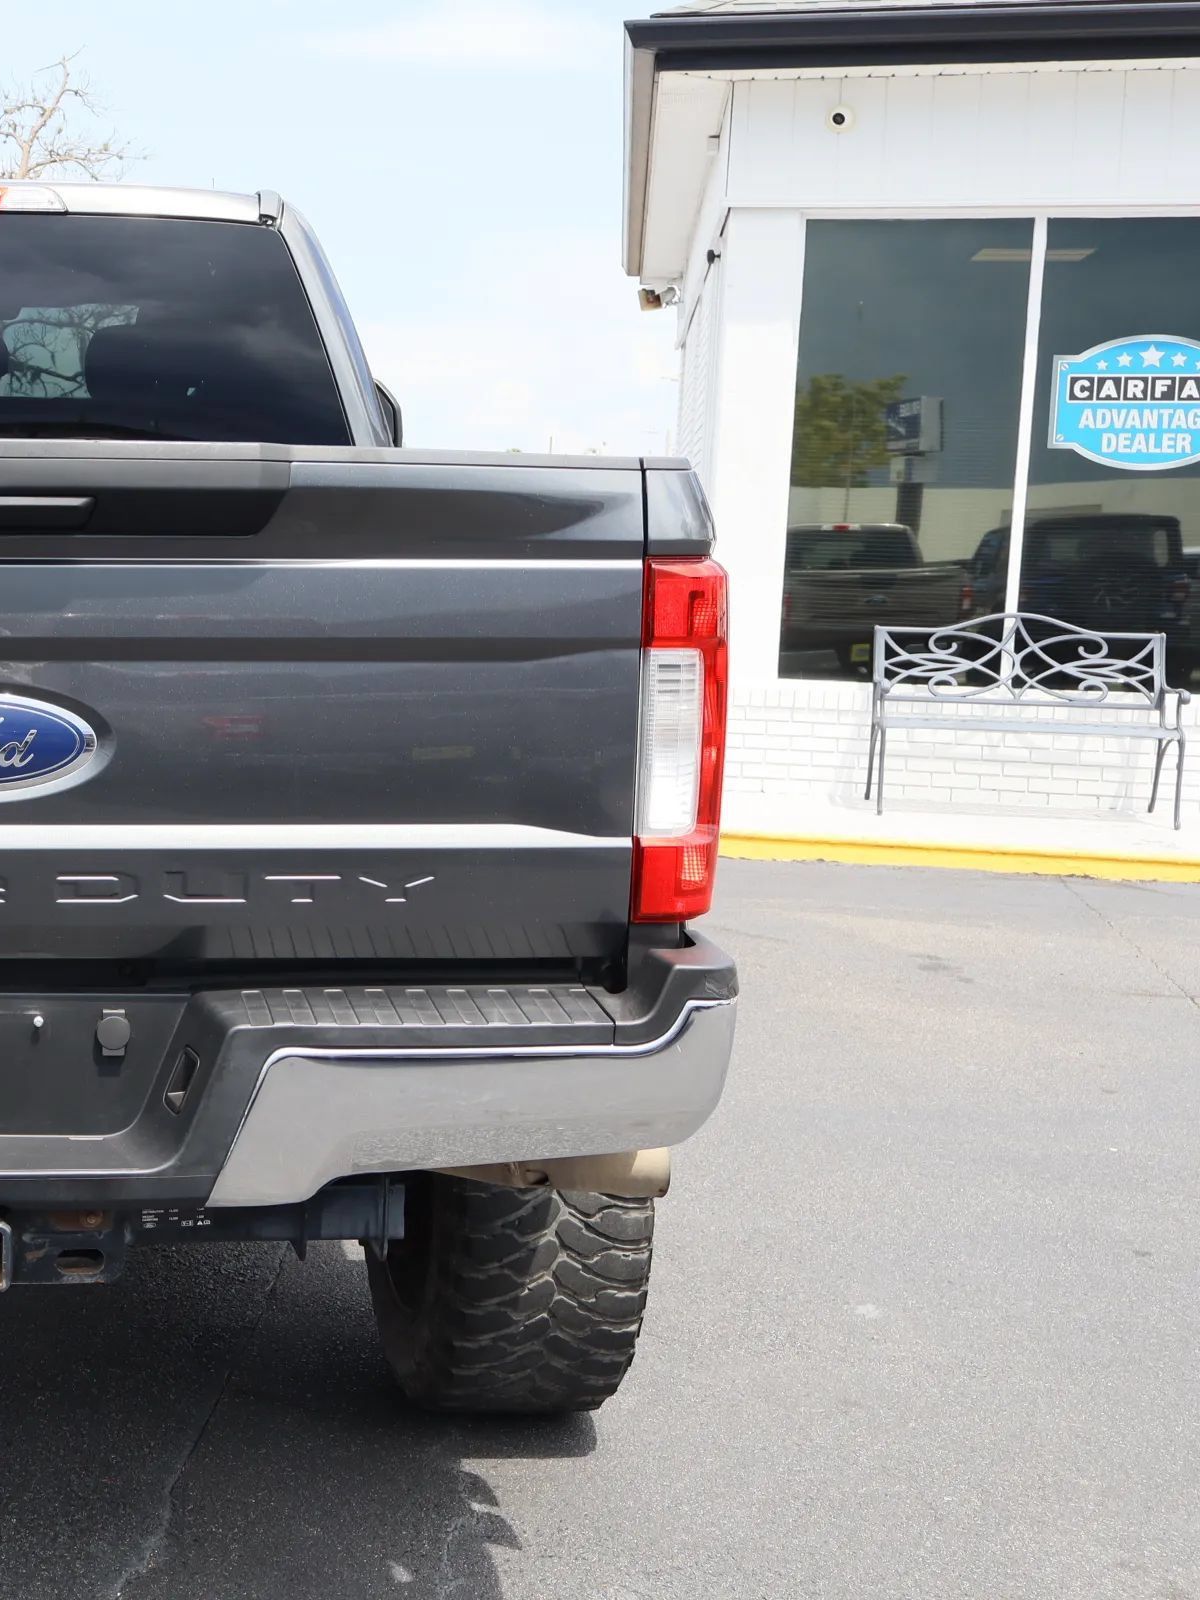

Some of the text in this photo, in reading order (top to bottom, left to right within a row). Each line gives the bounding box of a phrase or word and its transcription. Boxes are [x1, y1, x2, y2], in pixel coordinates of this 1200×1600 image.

[1073, 379, 1200, 399] CARFA
[1101, 432, 1192, 454] DEALER
[55, 870, 436, 904] DUTY
